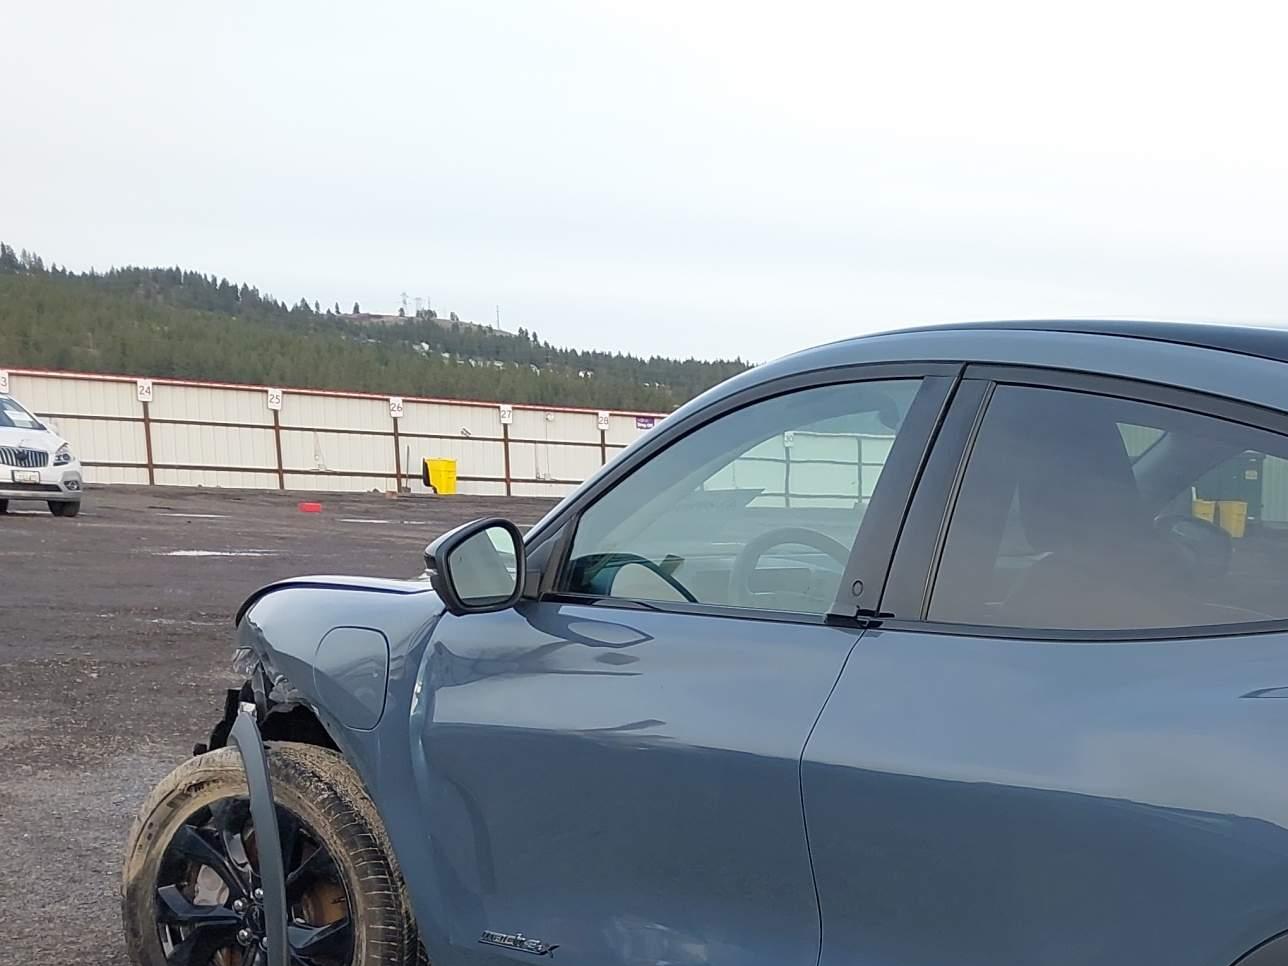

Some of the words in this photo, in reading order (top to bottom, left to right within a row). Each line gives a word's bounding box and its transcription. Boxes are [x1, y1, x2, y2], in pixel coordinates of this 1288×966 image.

[139, 385, 151, 396] 24
[269, 394, 280, 405] 25
[390, 402, 402, 412] 26
[501, 409, 512, 419] 27
[599, 416, 609, 425] 28
